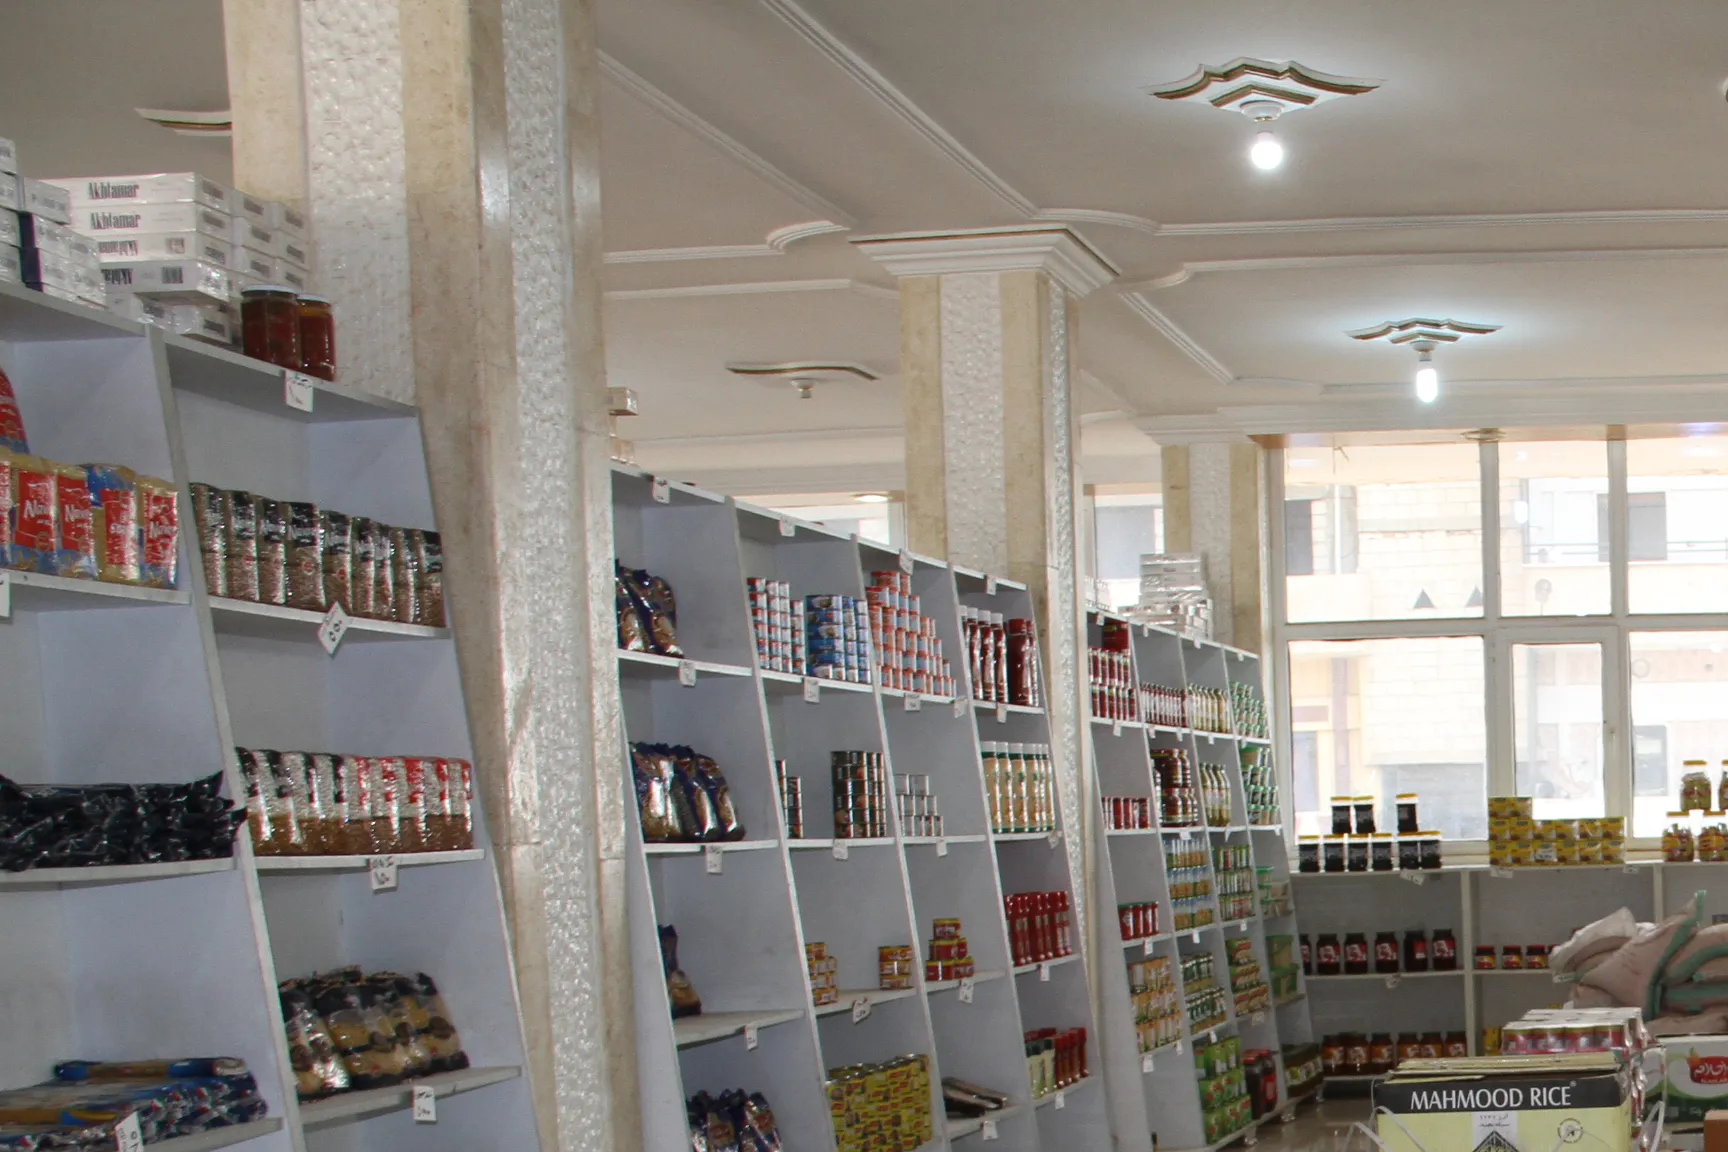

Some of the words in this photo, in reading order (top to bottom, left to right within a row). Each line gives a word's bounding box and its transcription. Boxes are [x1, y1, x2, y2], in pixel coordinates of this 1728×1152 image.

[88, 181, 139, 200] Akhtamar
[90, 212, 141, 229] Akhtamar
[1410, 1088, 1523, 1110] MAHMOOD
[1530, 1087, 1571, 1107] RICE
